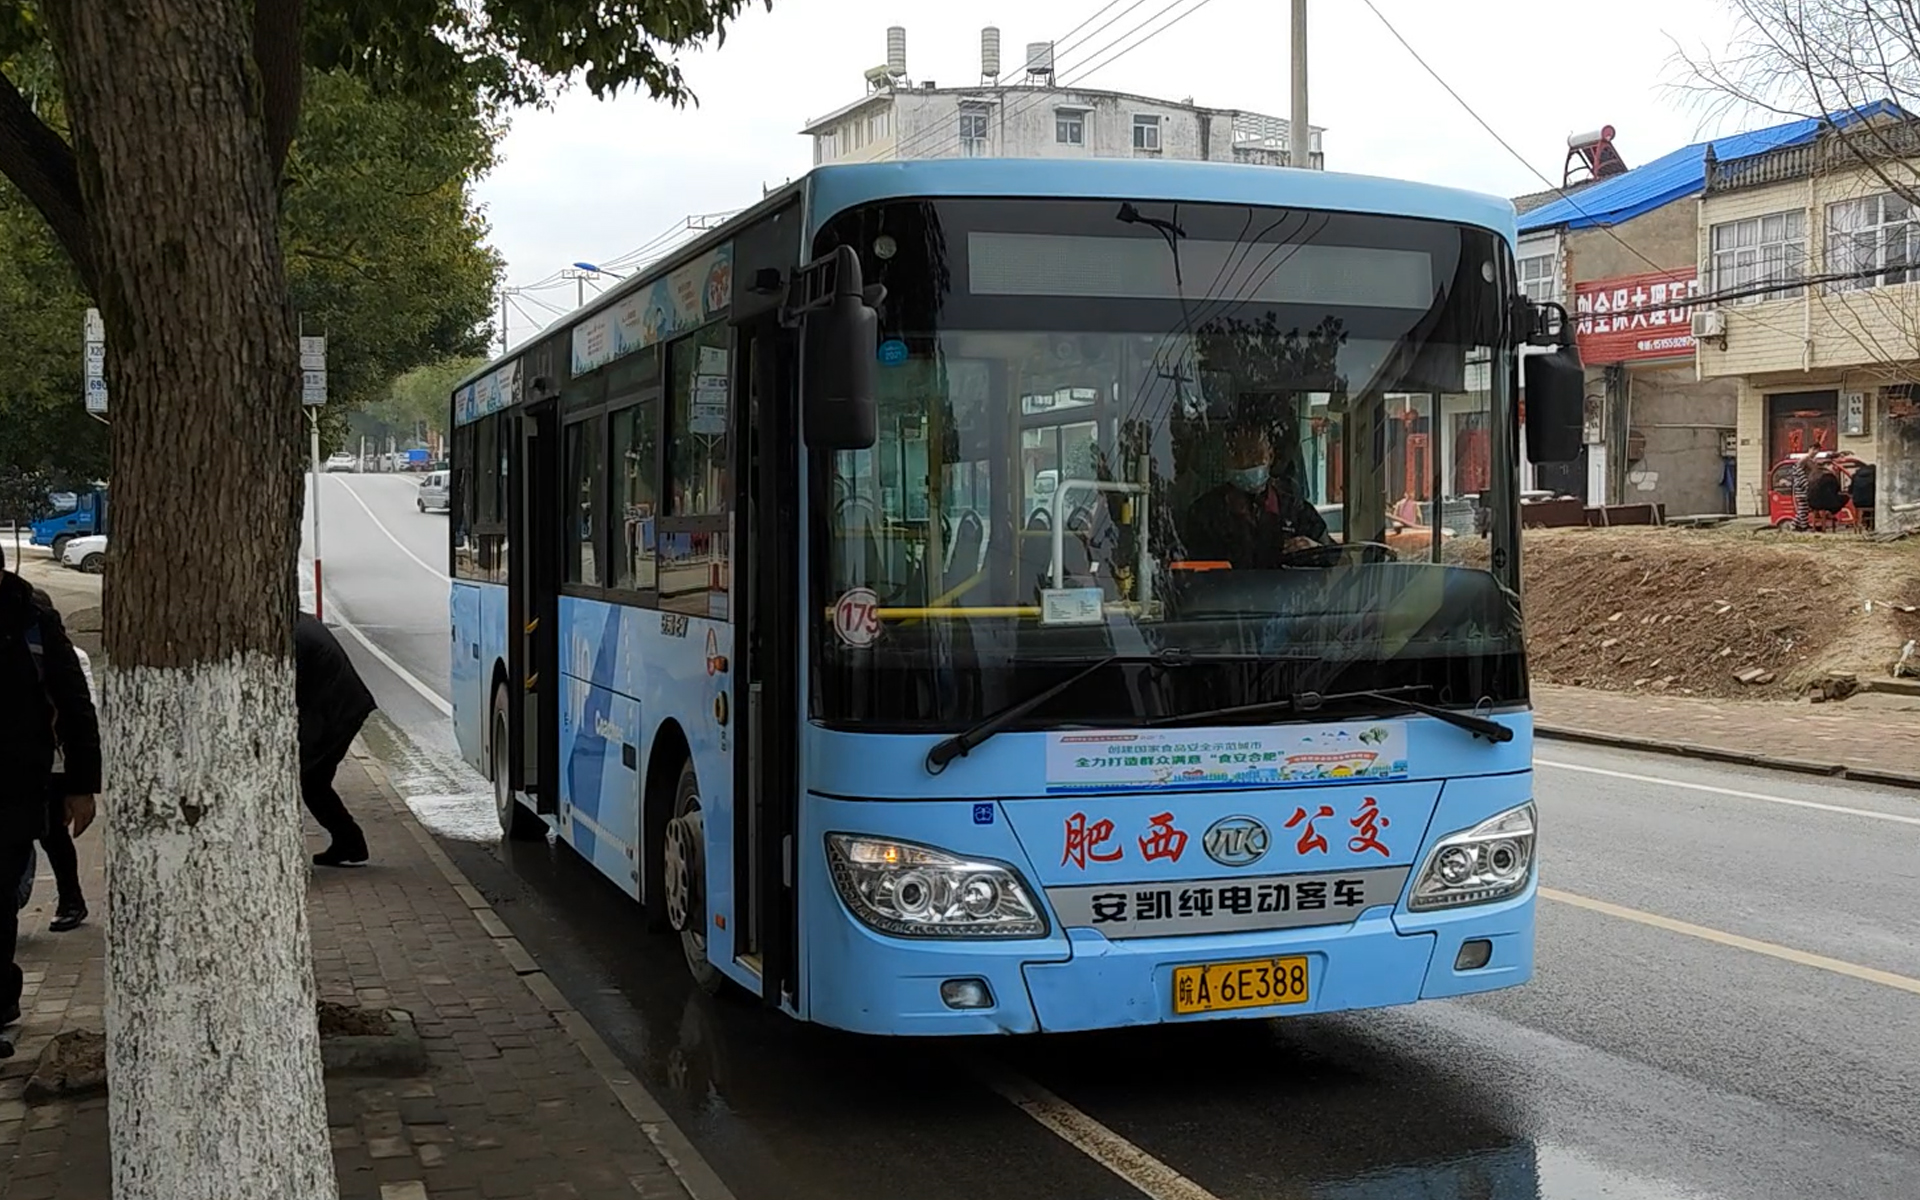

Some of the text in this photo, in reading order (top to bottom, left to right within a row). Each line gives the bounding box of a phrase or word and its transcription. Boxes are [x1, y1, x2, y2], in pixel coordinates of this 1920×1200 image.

[1108, 741, 1263, 755] 创建国家食品安全示范城市
[1061, 811, 1189, 871] 肥西
[1284, 797, 1391, 858] 公交
[1092, 878, 1366, 924] 安凯纯电动客车
